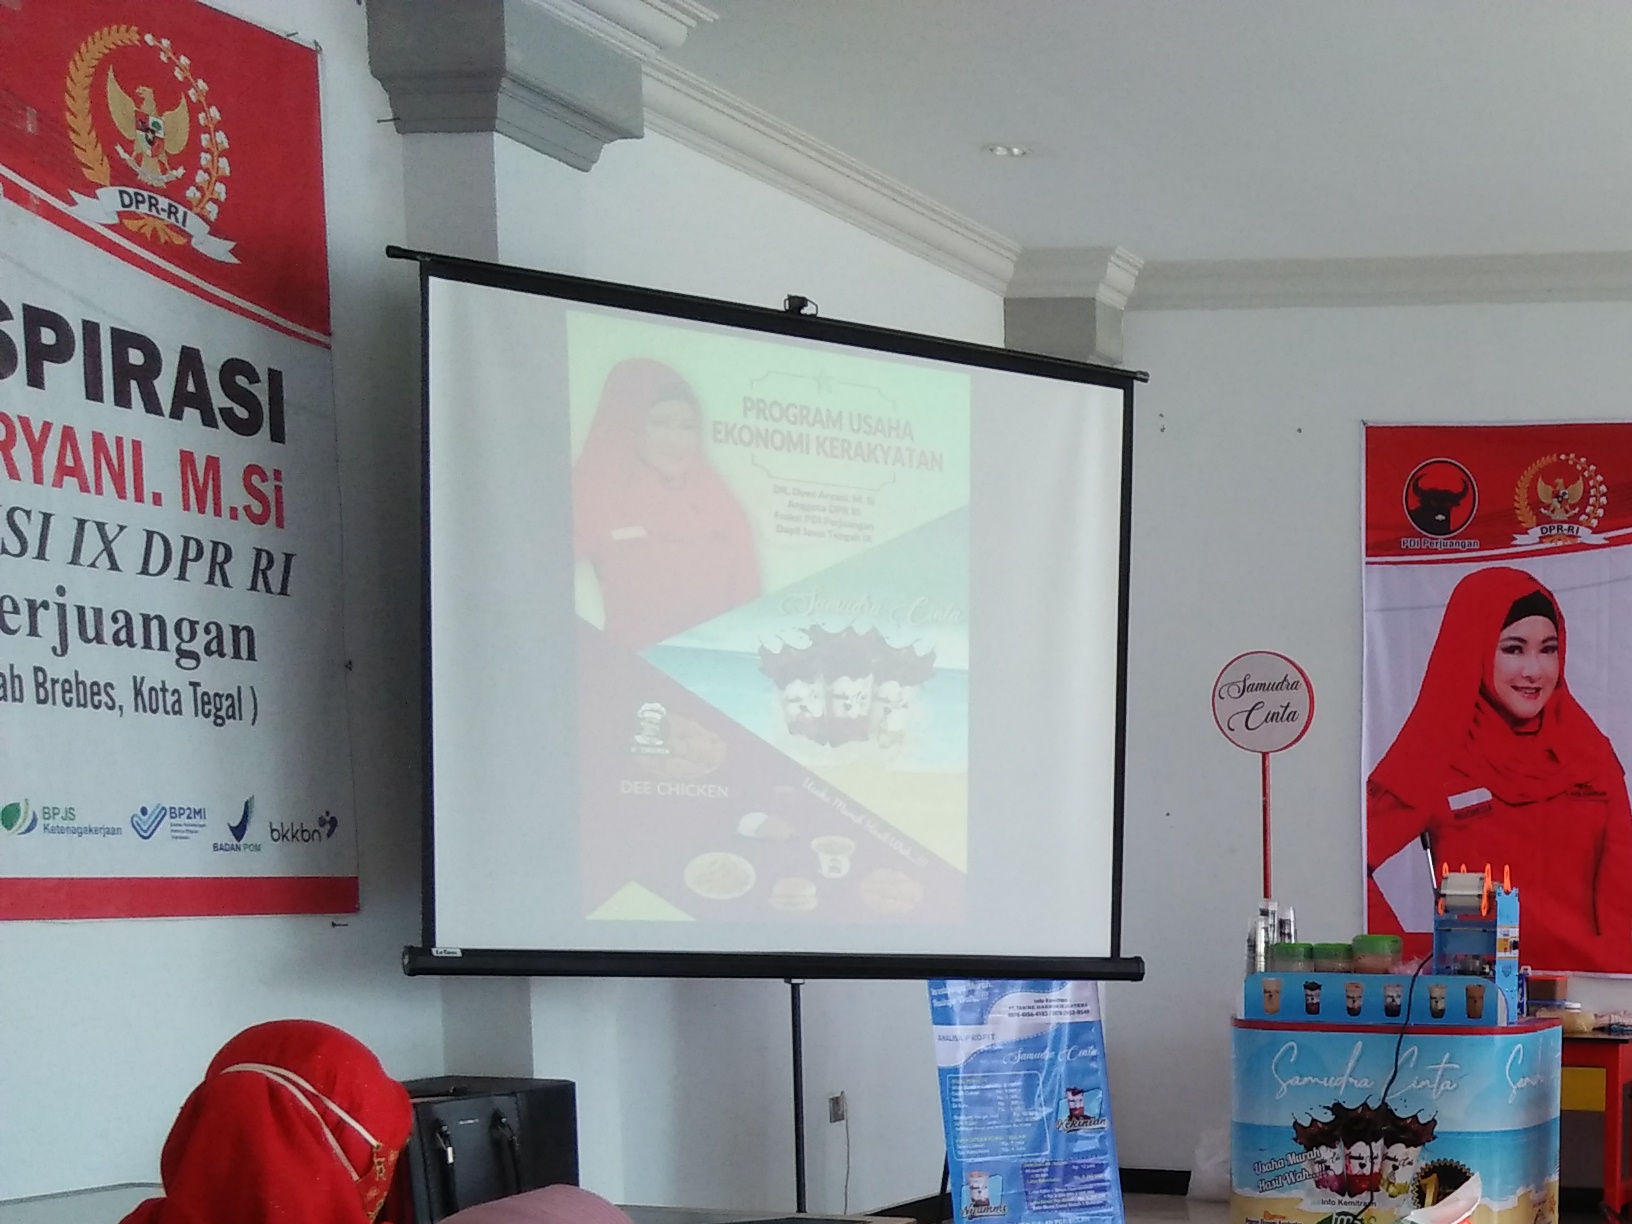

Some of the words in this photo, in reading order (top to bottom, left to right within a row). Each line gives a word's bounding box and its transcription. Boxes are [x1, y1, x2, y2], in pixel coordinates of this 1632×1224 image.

[119, 189, 187, 228] DPR-RI
[743, 396, 843, 431] PROGRAM
[849, 411, 914, 441] USAHA
[712, 420, 810, 455] EKONOMI
[816, 434, 944, 471] KERAKYATAN
[180, 449, 284, 528] M.Si
[1541, 525, 1579, 534] DPR-RI
[67, 517, 128, 572] IX
[136, 529, 233, 588] DPR
[247, 547, 296, 596] RI
[1402, 539, 1420, 548] PDI
[1422, 539, 1479, 550] Perjuangan
[33, 666, 123, 717] Brebes,
[132, 675, 182, 716] Kota
[189, 681, 242, 727] Tegal
[1218, 674, 1301, 699] Samudra
[1227, 701, 1299, 731] Cinta
[621, 780, 651, 794] DEE
[658, 782, 728, 798] CHICKEN
[42, 806, 75, 821] BPJS
[170, 807, 206, 819] BP2MI
[269, 822, 321, 842] bkkbn
[1272, 1041, 1375, 1099] Samudra
[1254, 1158, 1285, 1175] Usaha
[1286, 1147, 1322, 1166] Murah
[1258, 1175, 1283, 1193] Hasil
